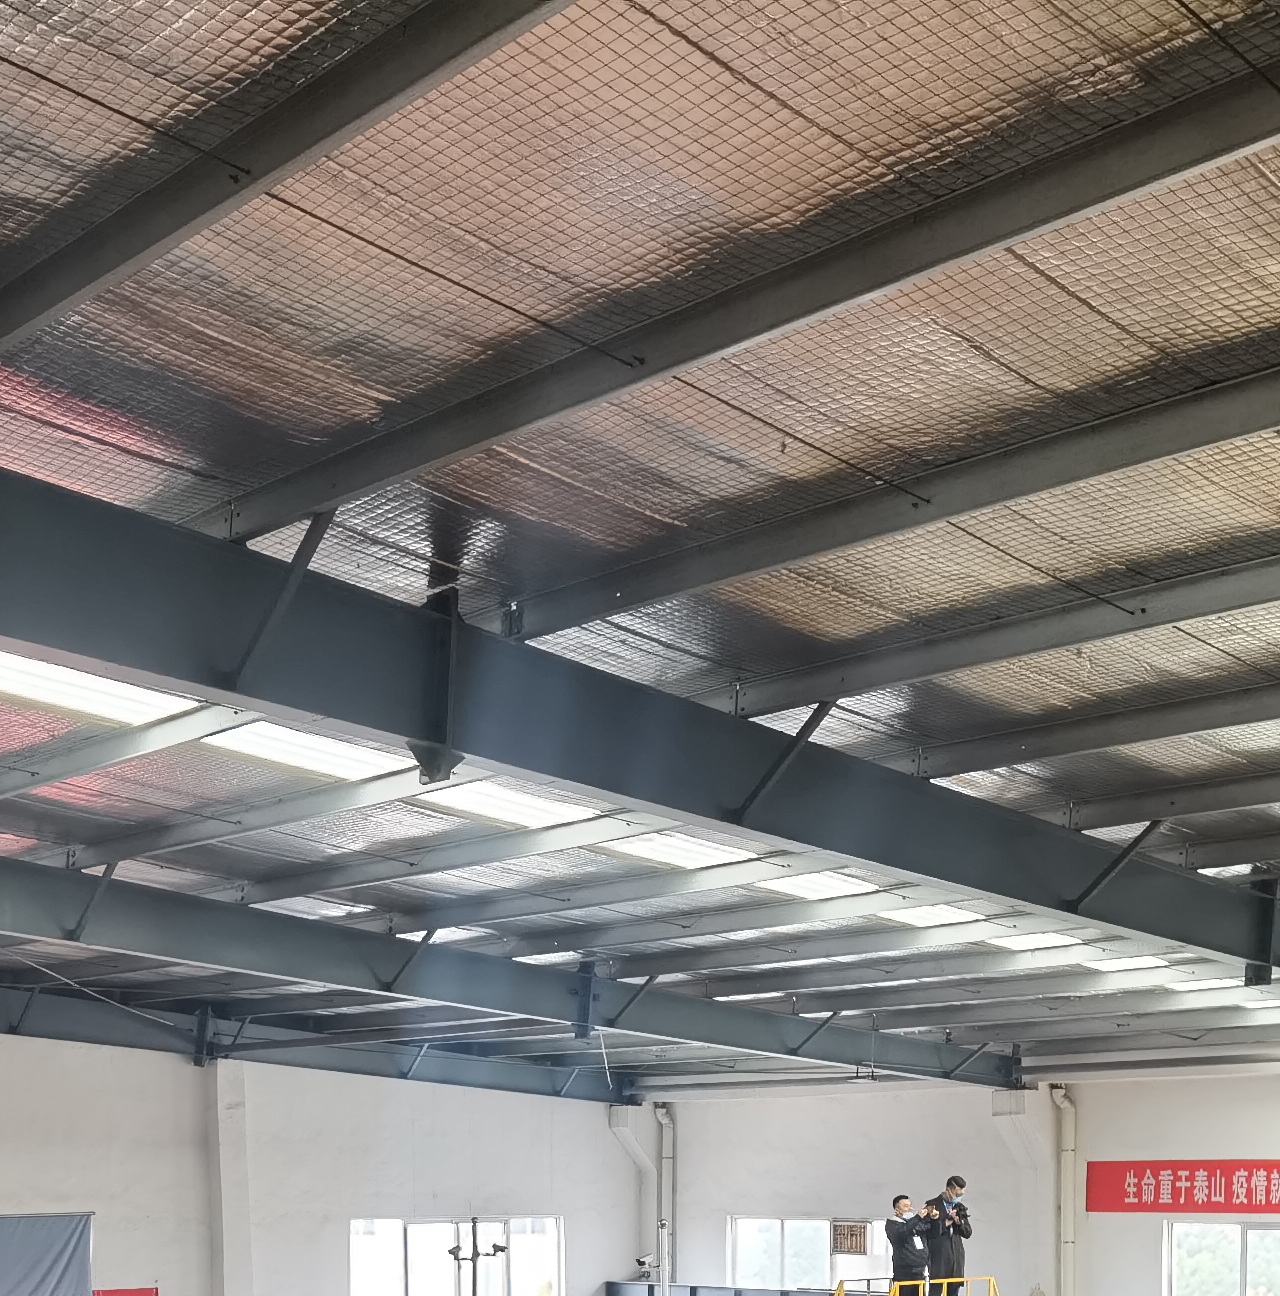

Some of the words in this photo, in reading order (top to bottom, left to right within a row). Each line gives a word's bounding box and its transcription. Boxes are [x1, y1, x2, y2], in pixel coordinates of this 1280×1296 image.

[1124, 1169, 1226, 1204] 生命重于泰山
